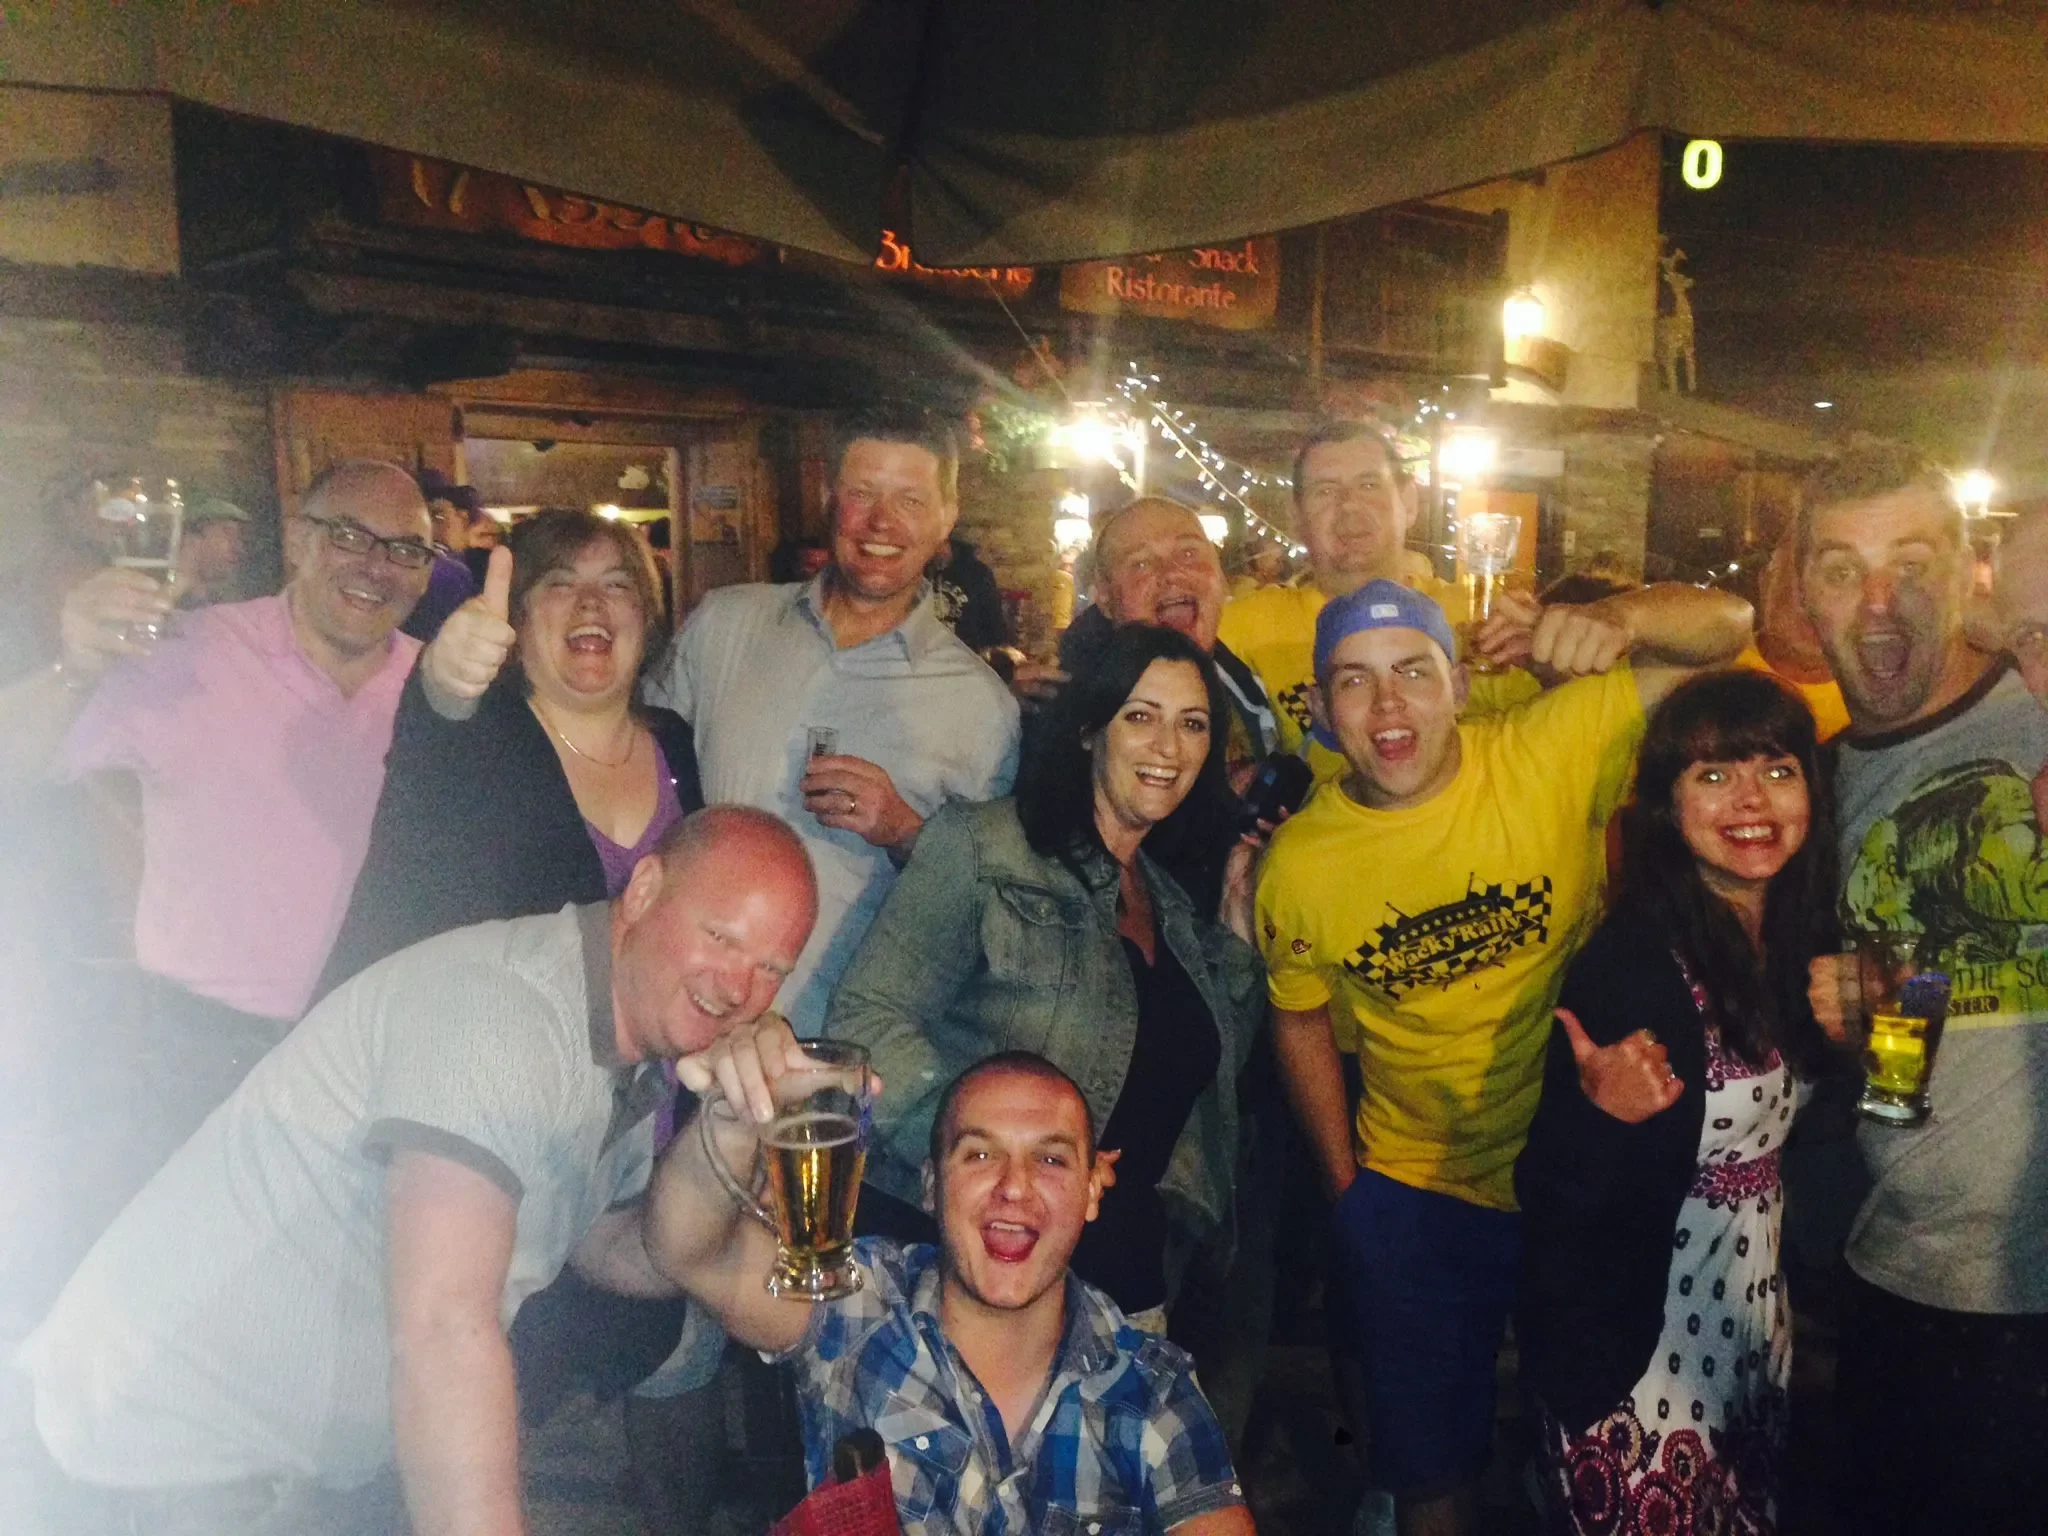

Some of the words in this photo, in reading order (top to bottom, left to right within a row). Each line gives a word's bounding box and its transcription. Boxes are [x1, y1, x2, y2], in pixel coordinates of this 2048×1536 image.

[1106, 265, 1237, 310] Ristorante
[1383, 934, 1456, 977] Wacky
[1456, 912, 1521, 943] Rally
[1956, 964, 2006, 993] THE
